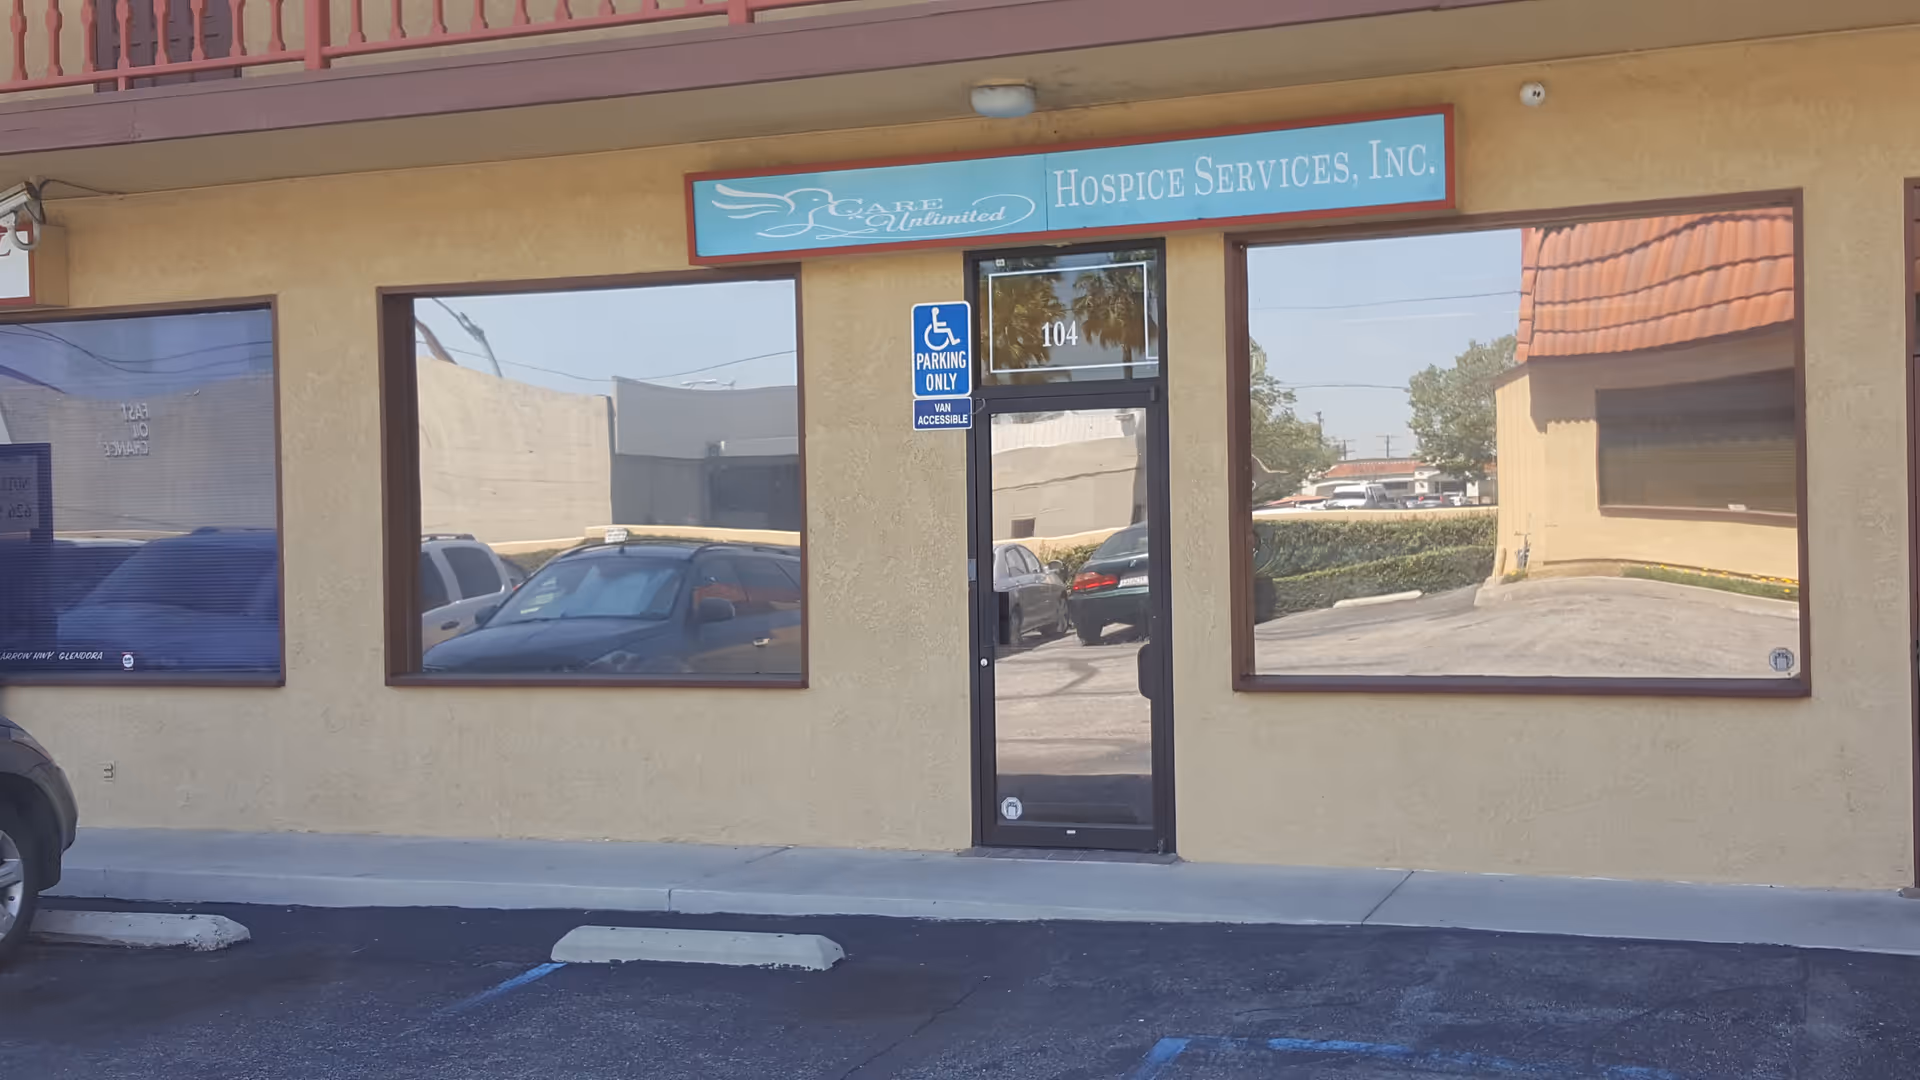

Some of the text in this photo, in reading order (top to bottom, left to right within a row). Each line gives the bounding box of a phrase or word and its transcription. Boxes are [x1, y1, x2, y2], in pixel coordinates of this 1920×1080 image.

[1053, 139, 1436, 208] HOSPICE SERVICES, INC.
[829, 198, 943, 217] CARE
[866, 206, 1006, 232] Unlimited
[1041, 320, 1079, 347] 104
[916, 350, 967, 371] PARKING
[925, 372, 958, 392] ONLY
[934, 403, 951, 413] VAN
[917, 414, 968, 425] ACCESSIBLE
[58, 651, 104, 660] GLENDORA
